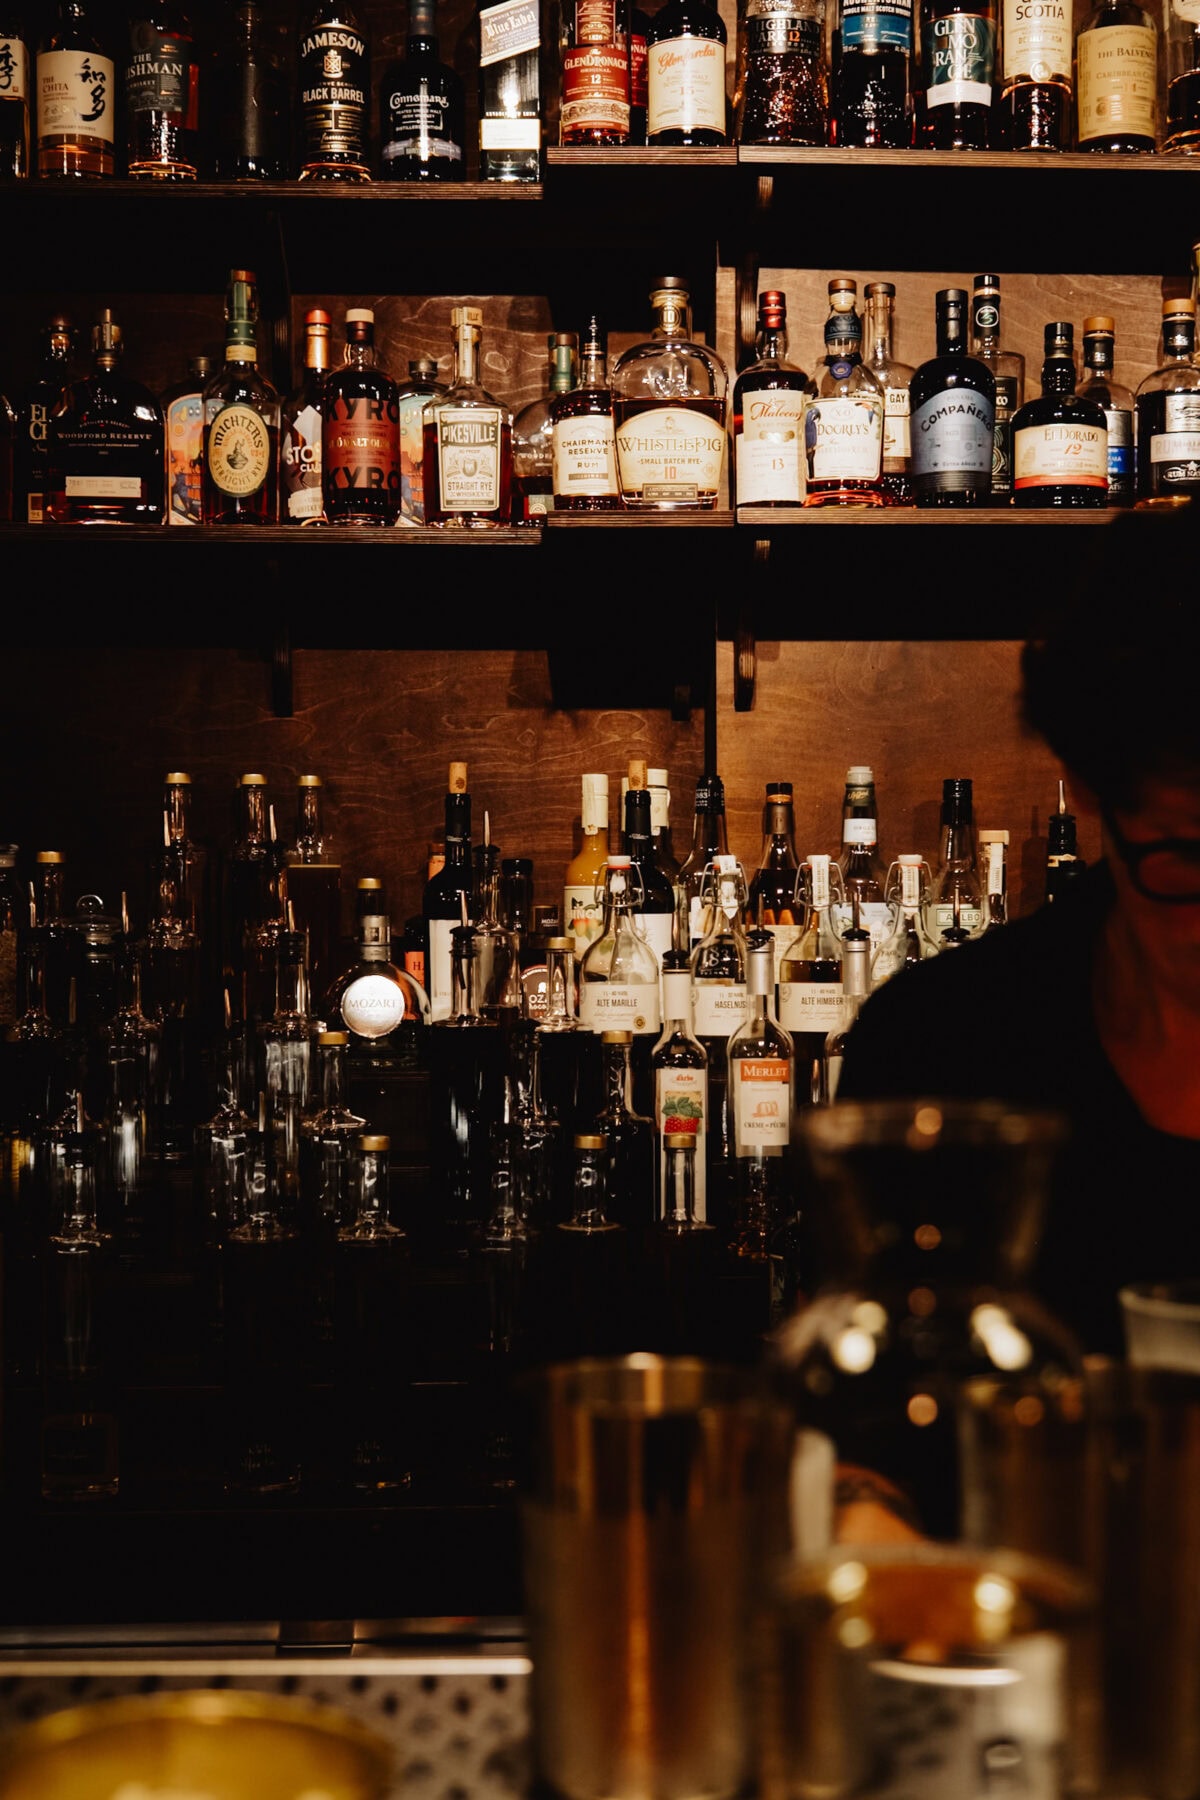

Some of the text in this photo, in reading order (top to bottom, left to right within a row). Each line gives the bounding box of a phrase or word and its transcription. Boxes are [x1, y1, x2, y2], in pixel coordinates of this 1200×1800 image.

[1015, 5, 1065, 20] SCOTIA
[485, 10, 537, 39] Blue Label
[934, 18, 976, 36] GLEN
[759, 30, 801, 42] ARK 12
[948, 33, 977, 49] MO
[301, 32, 365, 58] JAMESON
[133, 53, 152, 63] THE
[935, 49, 967, 67] RAN
[590, 74, 602, 84] 12
[43, 83, 69, 93] CHITA
[302, 87, 365, 104] BLACK BARREL
[920, 403, 992, 433] COMPAÑERO
[110, 432, 152, 440] RESERVE
[442, 424, 496, 443] PIKESVILLE
[561, 440, 615, 448] CHAIRMAN'S
[1166, 470, 1187, 478] RUM
[447, 482, 493, 491] STRAIGHT RYE
[349, 999, 396, 1009] MOZART
[596, 999, 639, 1008] ALTE MARILLE
[801, 996, 844, 1006] ALTE HIMBEER
[743, 1065, 788, 1077] MERLET
